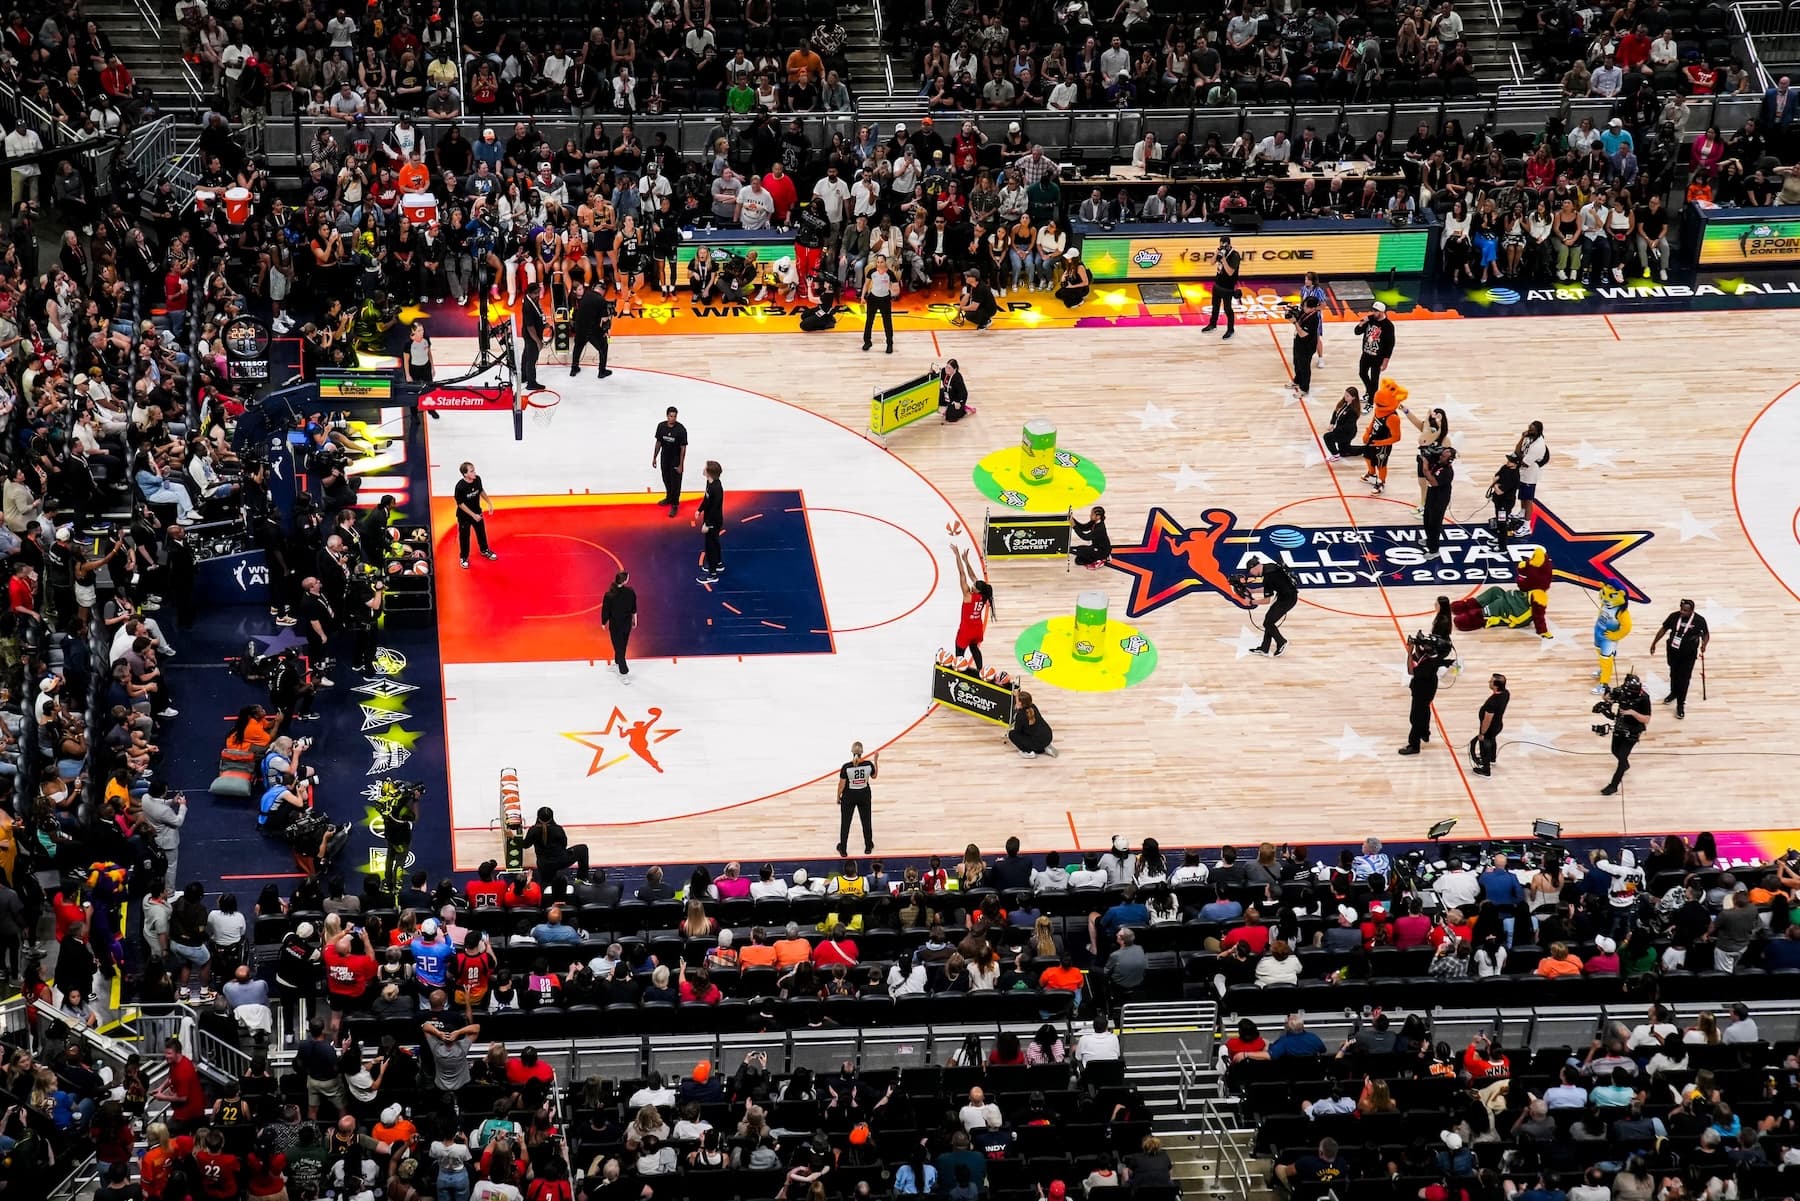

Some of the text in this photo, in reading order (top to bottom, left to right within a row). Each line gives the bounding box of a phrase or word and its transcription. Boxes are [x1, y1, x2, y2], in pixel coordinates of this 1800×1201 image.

[415, 208, 425, 218] G
[1763, 238, 1800, 248] POIN
[1190, 251, 1201, 262] 3
[1526, 288, 1588, 302] AT&T
[1596, 284, 1727, 299] WNBA
[1312, 527, 1497, 545] AT&T WBA
[1236, 544, 1548, 570] ALL STAR
[1298, 567, 1514, 585] NDY 2025
[974, 601, 983, 612] 15
[854, 769, 865, 780] 26
[416, 955, 438, 973] 32
[222, 1106, 238, 1121] 22
[985, 1143, 1006, 1153] INDY
[204, 1164, 221, 1178] 22
